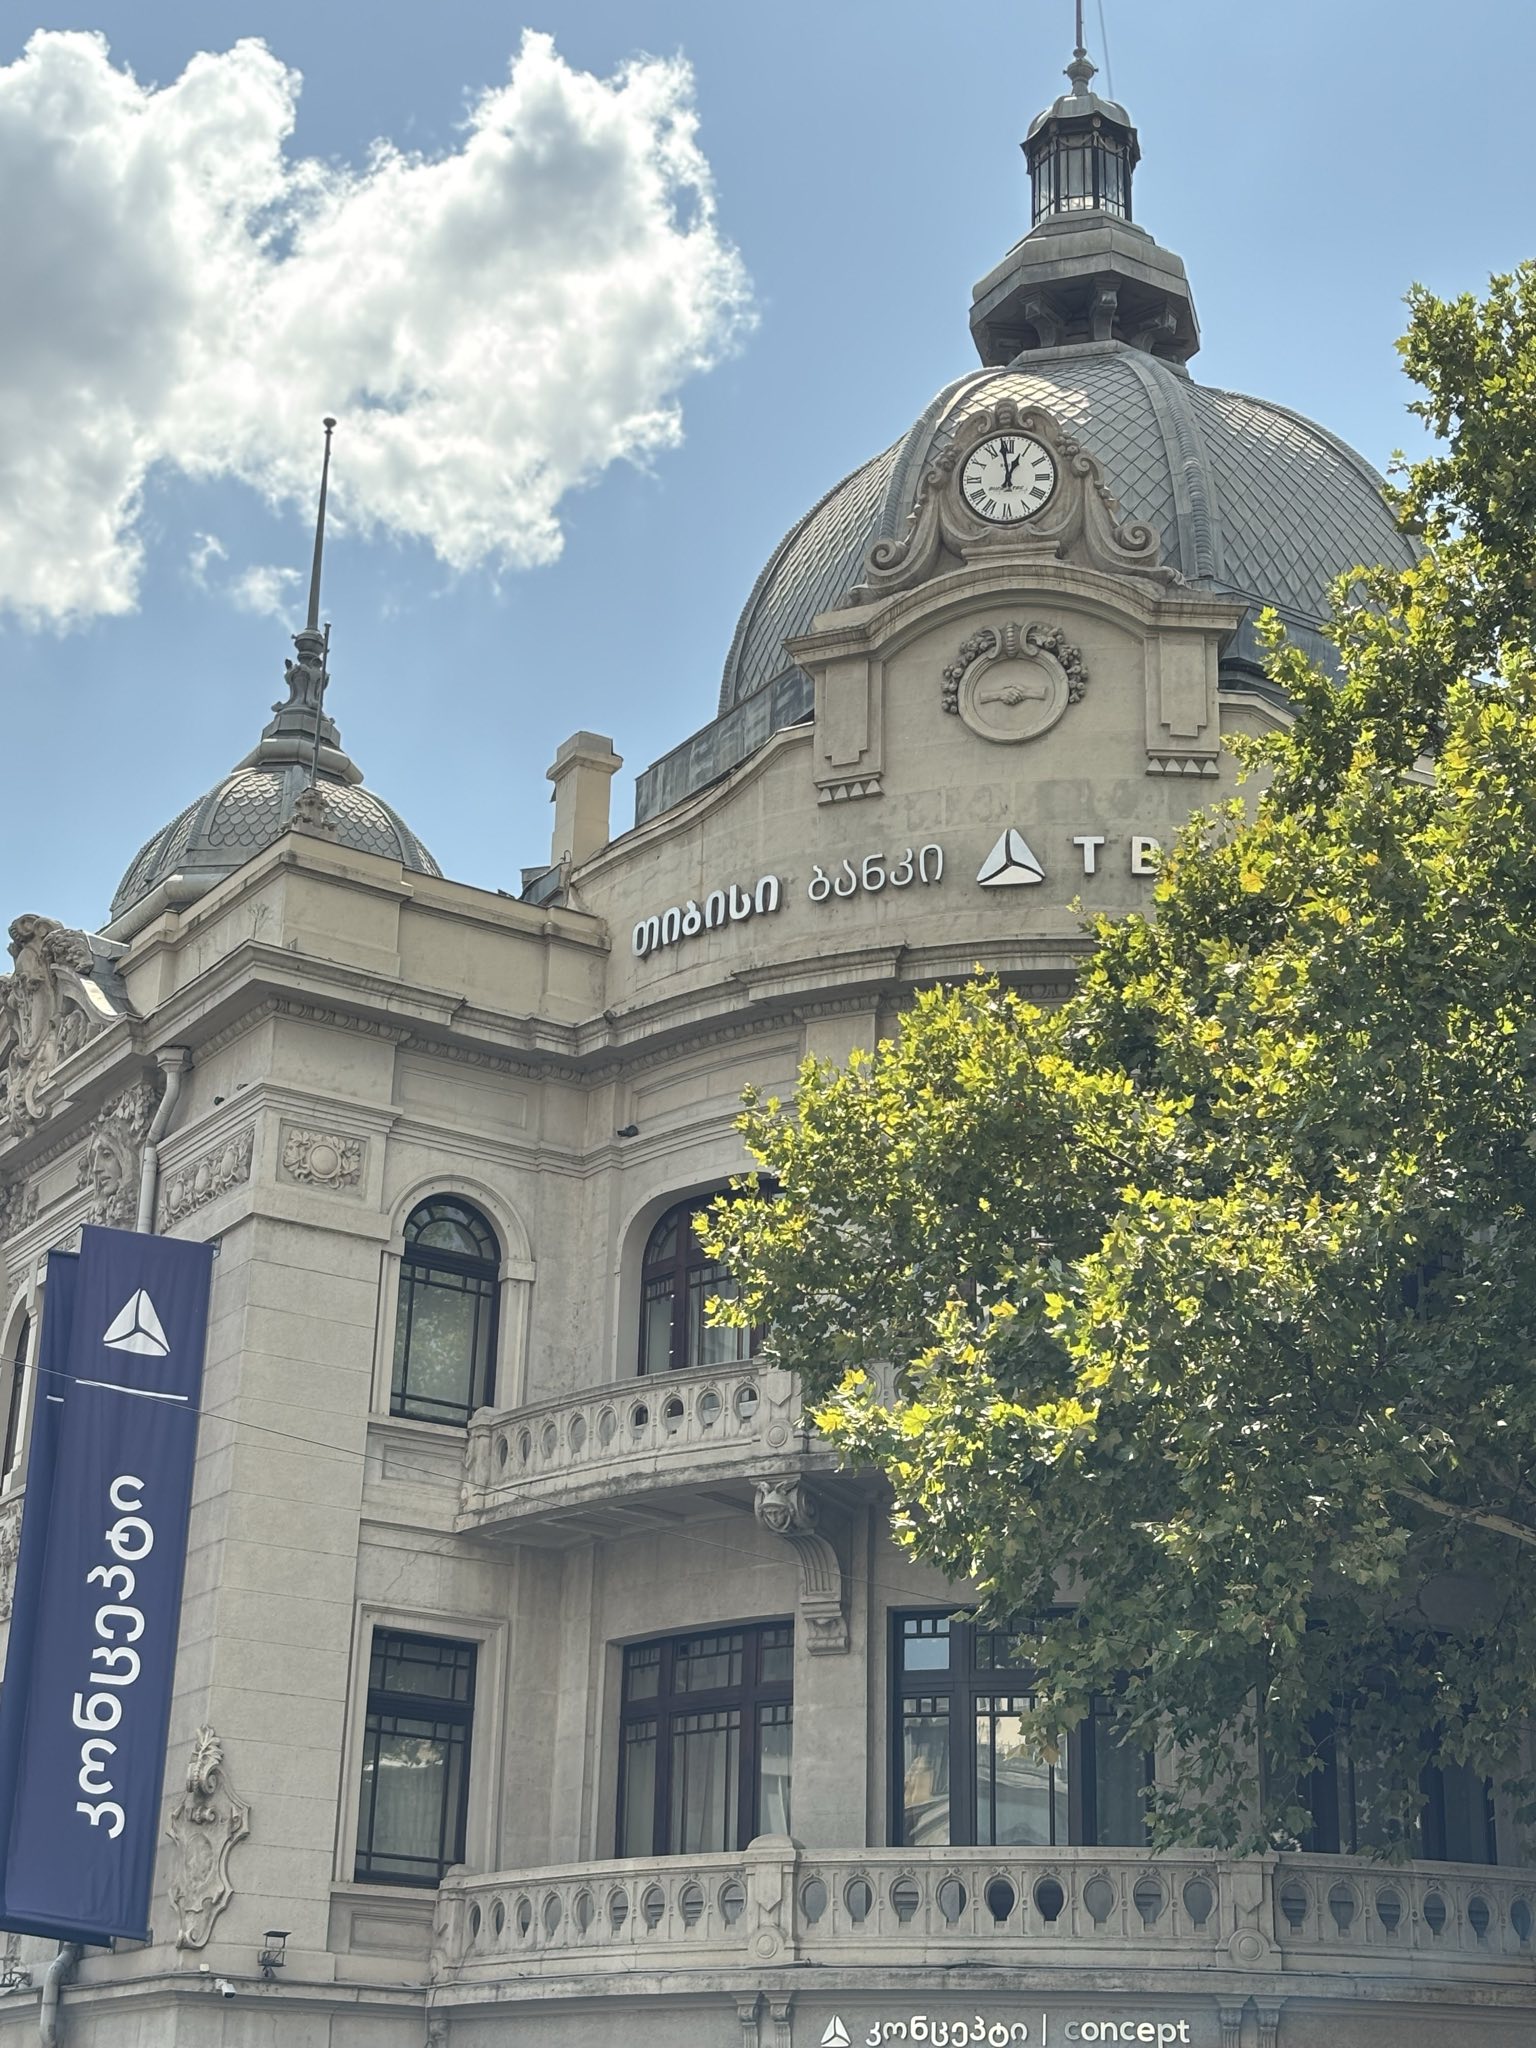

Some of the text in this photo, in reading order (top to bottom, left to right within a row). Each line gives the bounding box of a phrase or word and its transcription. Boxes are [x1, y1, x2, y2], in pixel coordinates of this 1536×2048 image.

[807, 844, 944, 902] ბანკი
[72, 1475, 154, 1839] კონცეპტი
[865, 2015, 1190, 2048] კონცეპტი concept
